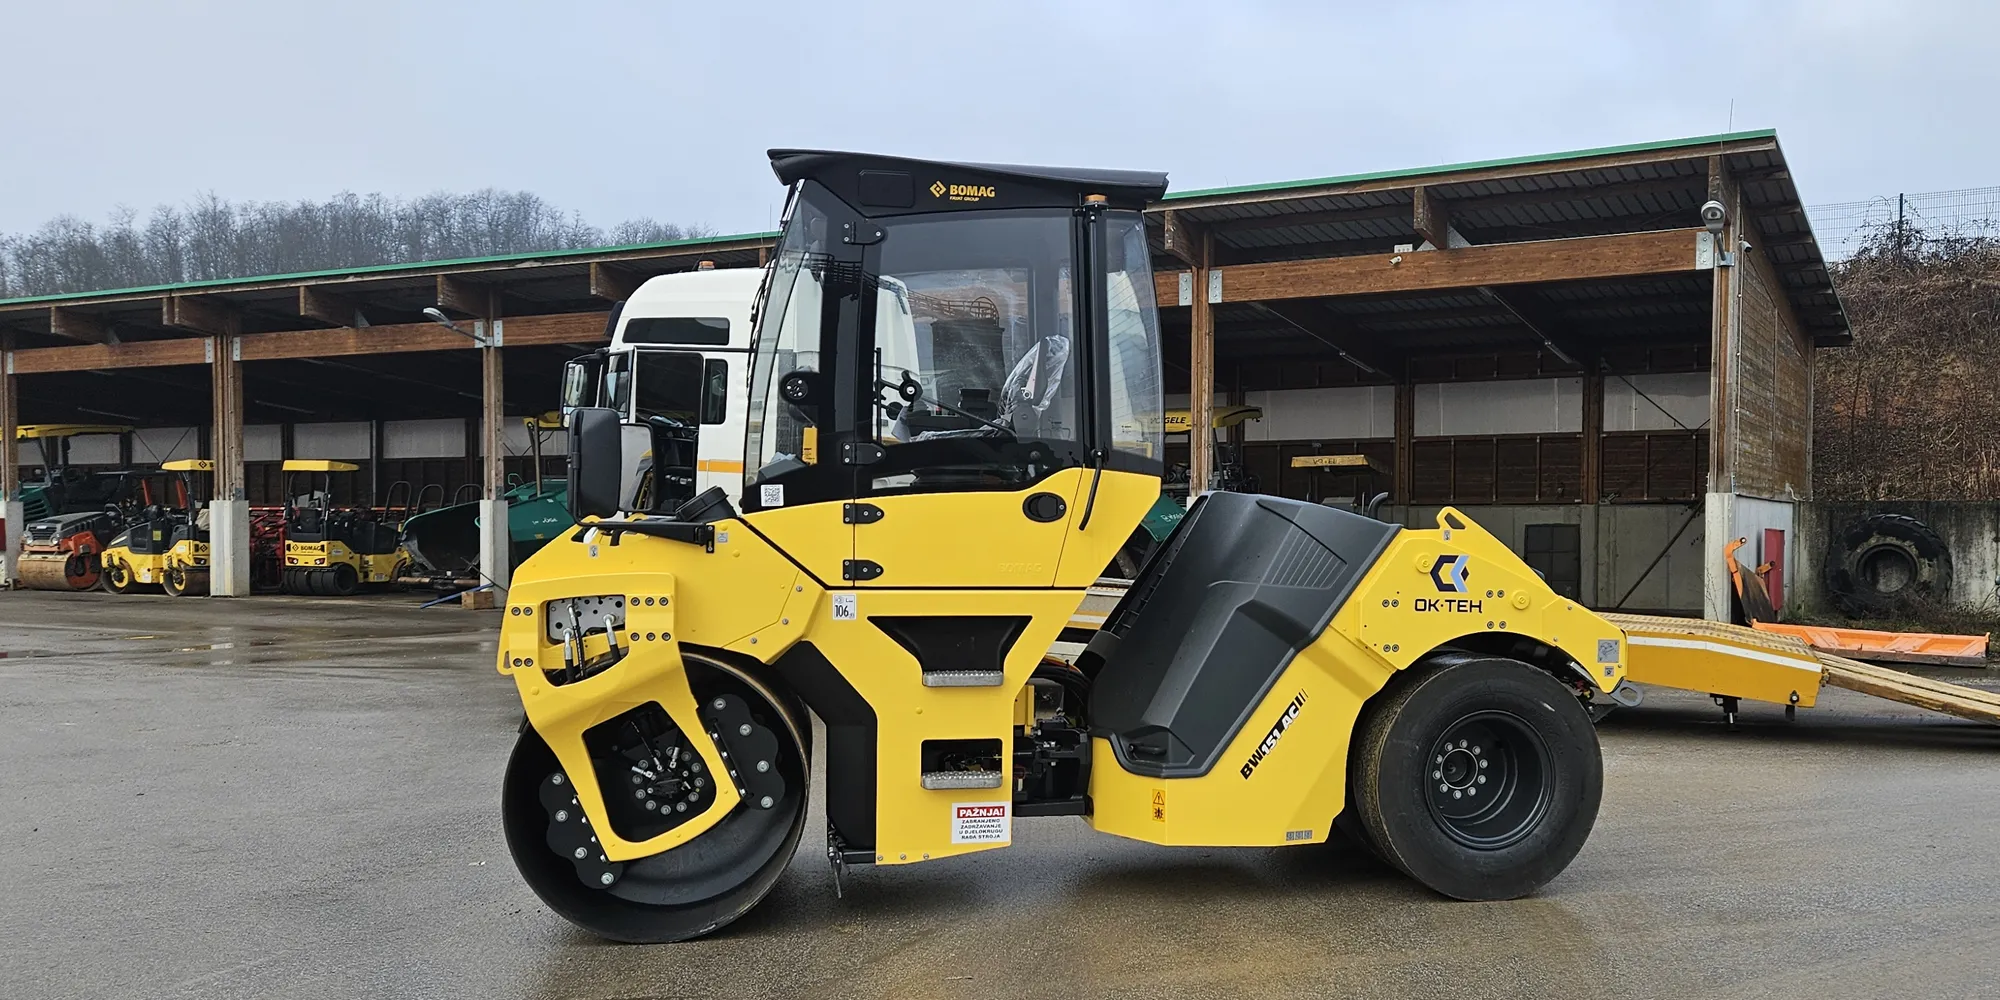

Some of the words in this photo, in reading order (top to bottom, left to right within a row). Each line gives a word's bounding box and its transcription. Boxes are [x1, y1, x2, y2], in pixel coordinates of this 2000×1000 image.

[949, 184, 996, 197] BOMAG
[835, 604, 848, 617] 106
[959, 807, 1004, 818] PAŽNJA!
